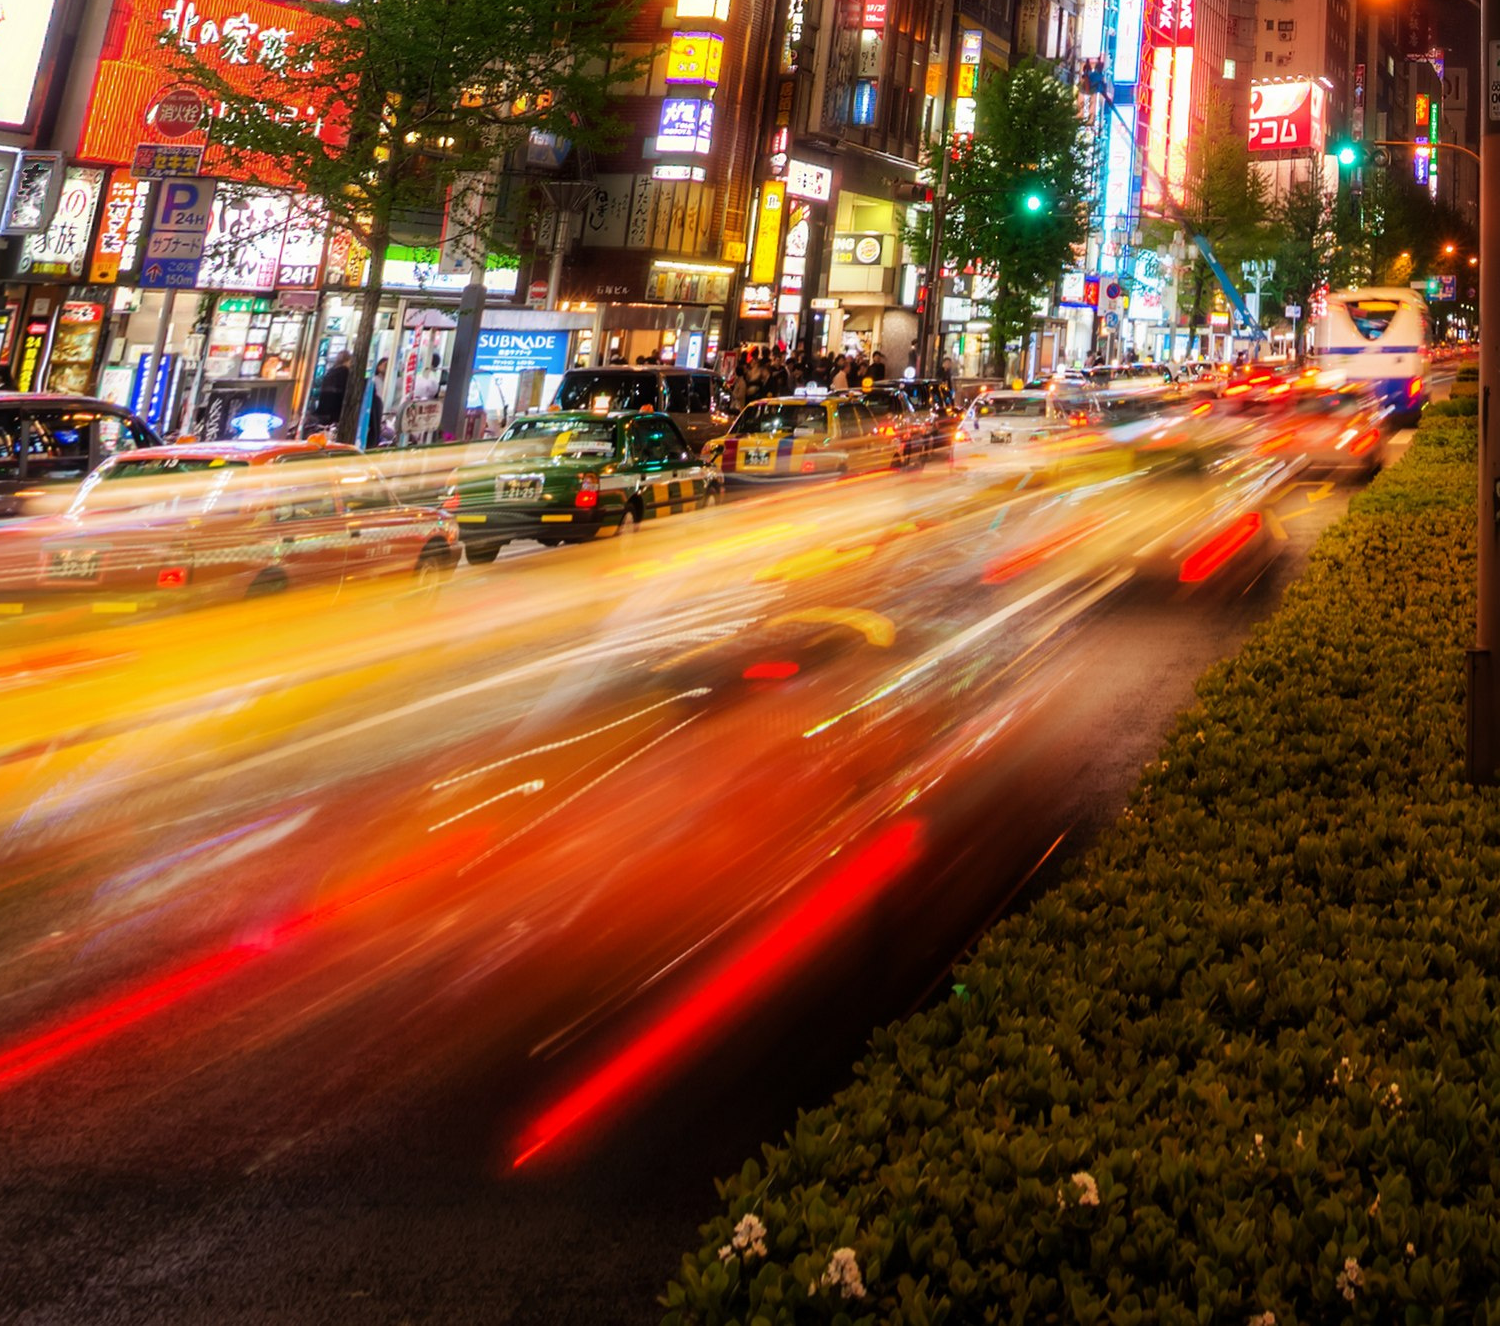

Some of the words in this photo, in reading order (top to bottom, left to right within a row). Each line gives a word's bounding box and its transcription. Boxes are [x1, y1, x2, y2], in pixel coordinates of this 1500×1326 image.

[161, 182, 199, 225] P
[175, 212, 206, 226] 24H
[164, 274, 194, 286] 150m
[279, 266, 318, 285] 24H
[478, 332, 557, 351] SUBNADE
